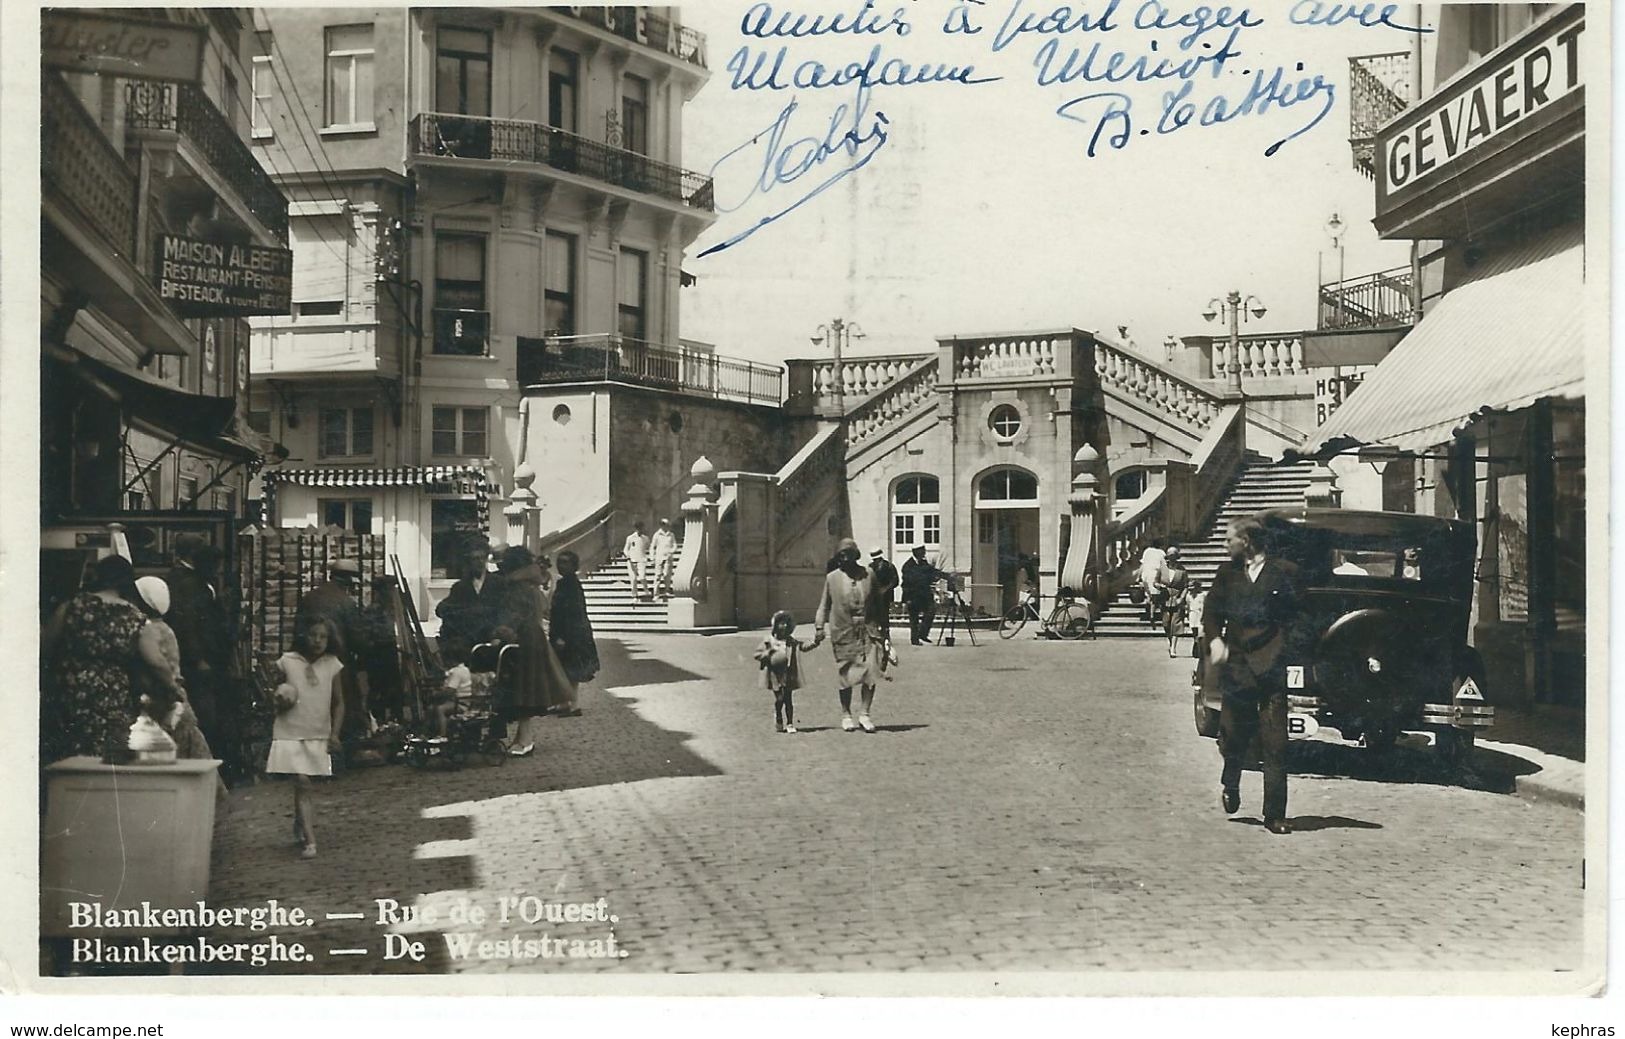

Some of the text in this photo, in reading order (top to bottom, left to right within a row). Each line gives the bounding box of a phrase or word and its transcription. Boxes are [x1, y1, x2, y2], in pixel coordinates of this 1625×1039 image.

[1388, 24, 1585, 187] GEVAERT
[163, 235, 291, 273] MAISON ALBERT
[160, 278, 224, 304] BIFSTEACK
[1288, 717, 1306, 734] B
